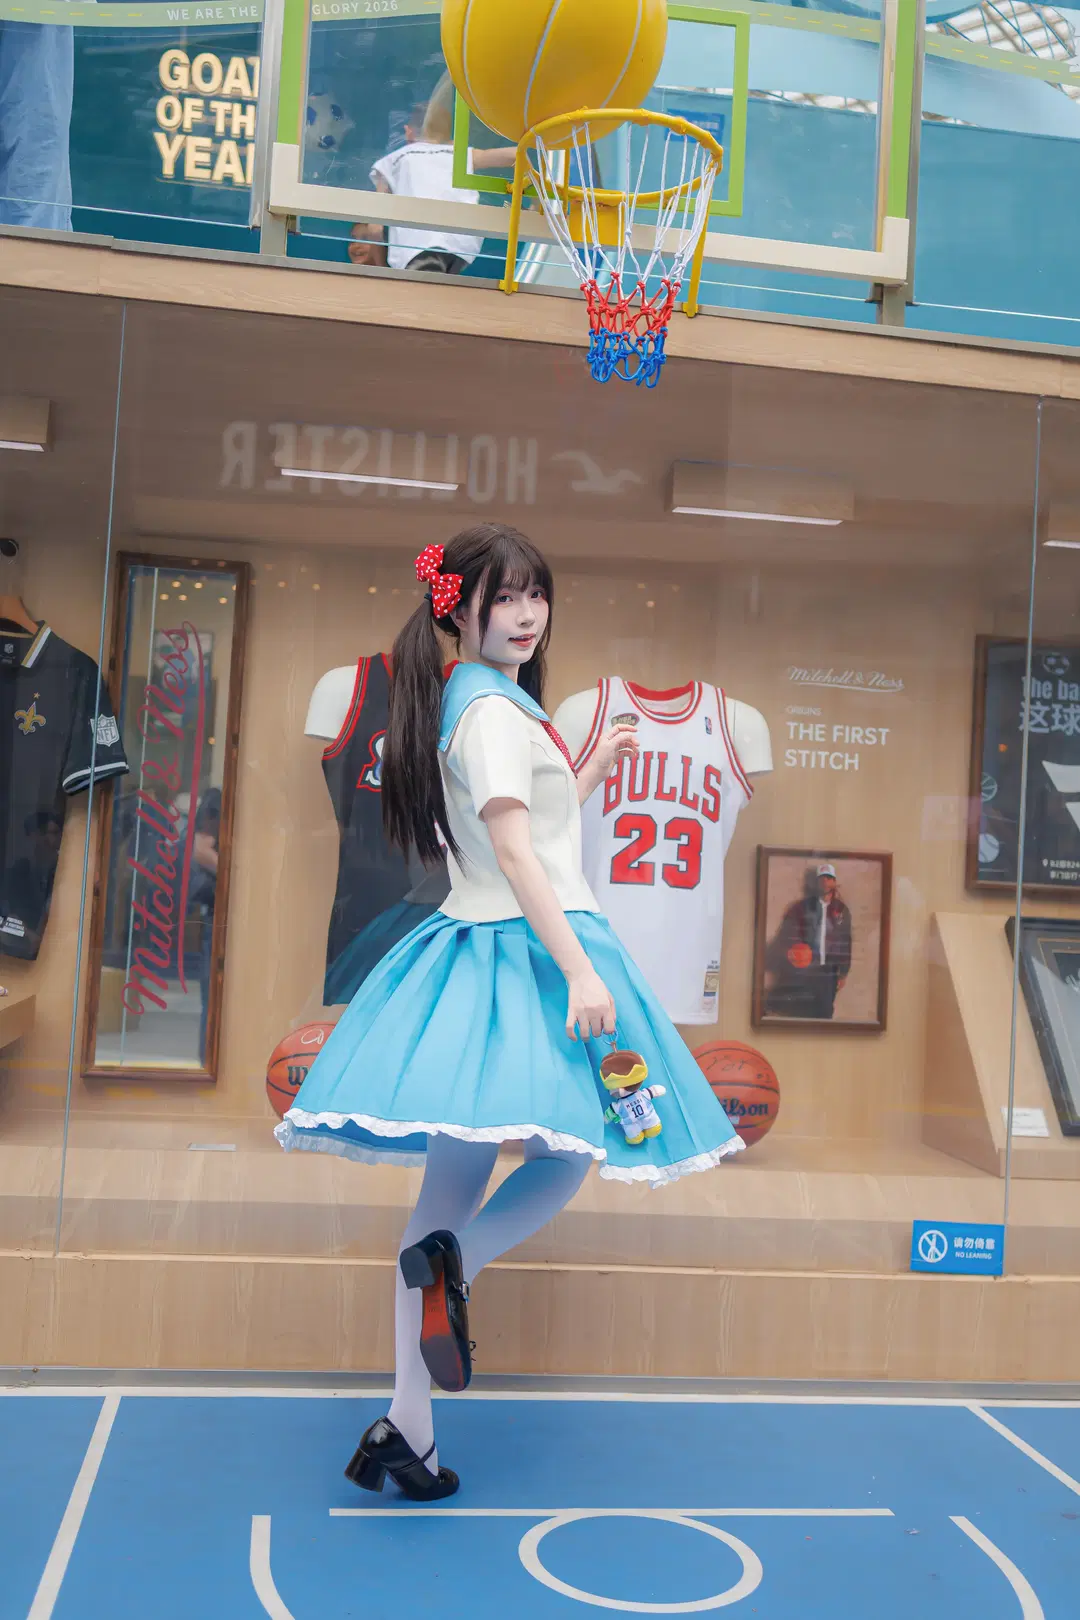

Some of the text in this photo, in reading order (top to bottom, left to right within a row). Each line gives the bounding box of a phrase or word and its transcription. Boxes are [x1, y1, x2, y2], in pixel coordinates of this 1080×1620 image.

[166, 0, 398, 21] WE ARE THE GLORY 2026
[156, 95, 204, 132] OF
[788, 665, 854, 684] Mitchell
[867, 671, 905, 690] Ness
[785, 721, 891, 746] THE FIRST
[784, 748, 860, 771] STITCH
[121, 621, 190, 1015] Mitchell & Ness
[610, 812, 703, 890] 23
[631, 1104, 645, 1119] 10
[966, 1252, 992, 1260] LEANING
